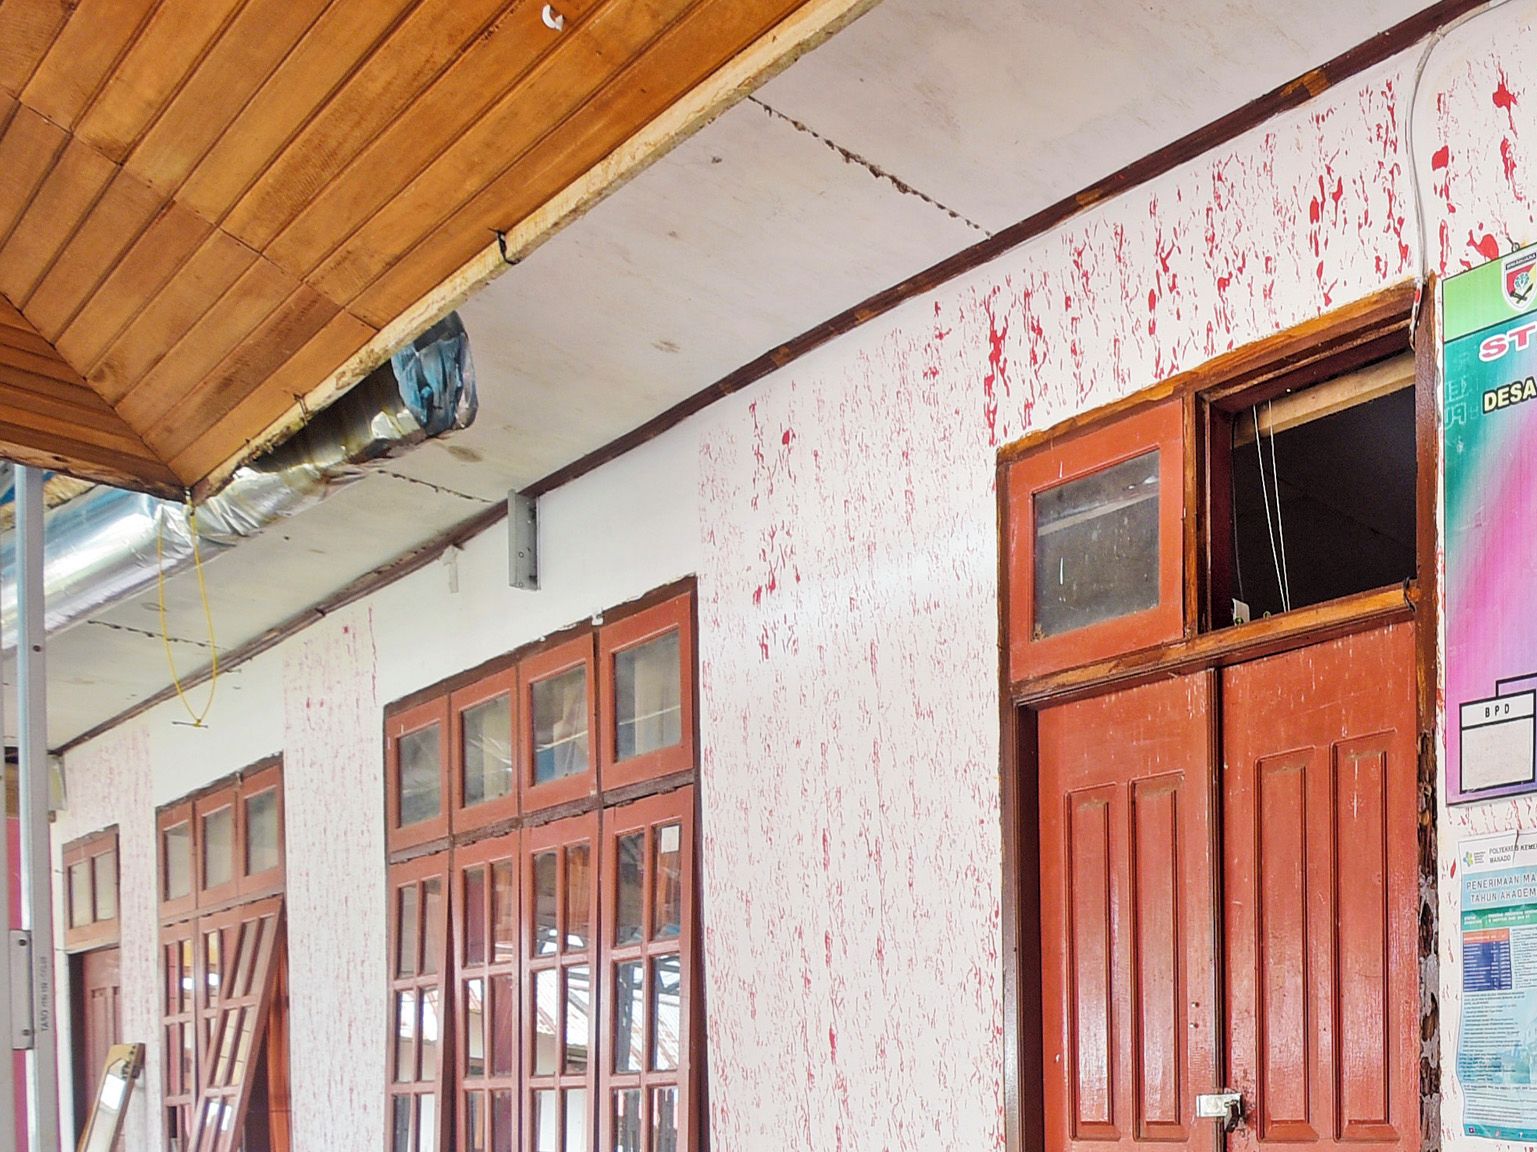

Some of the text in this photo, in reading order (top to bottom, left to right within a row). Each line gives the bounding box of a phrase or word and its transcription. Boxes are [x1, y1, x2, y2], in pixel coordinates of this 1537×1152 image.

[1483, 377, 1537, 414] DESA
[1466, 877, 1520, 890] PENERIMAAN
[1471, 890, 1497, 903] TAHUN
